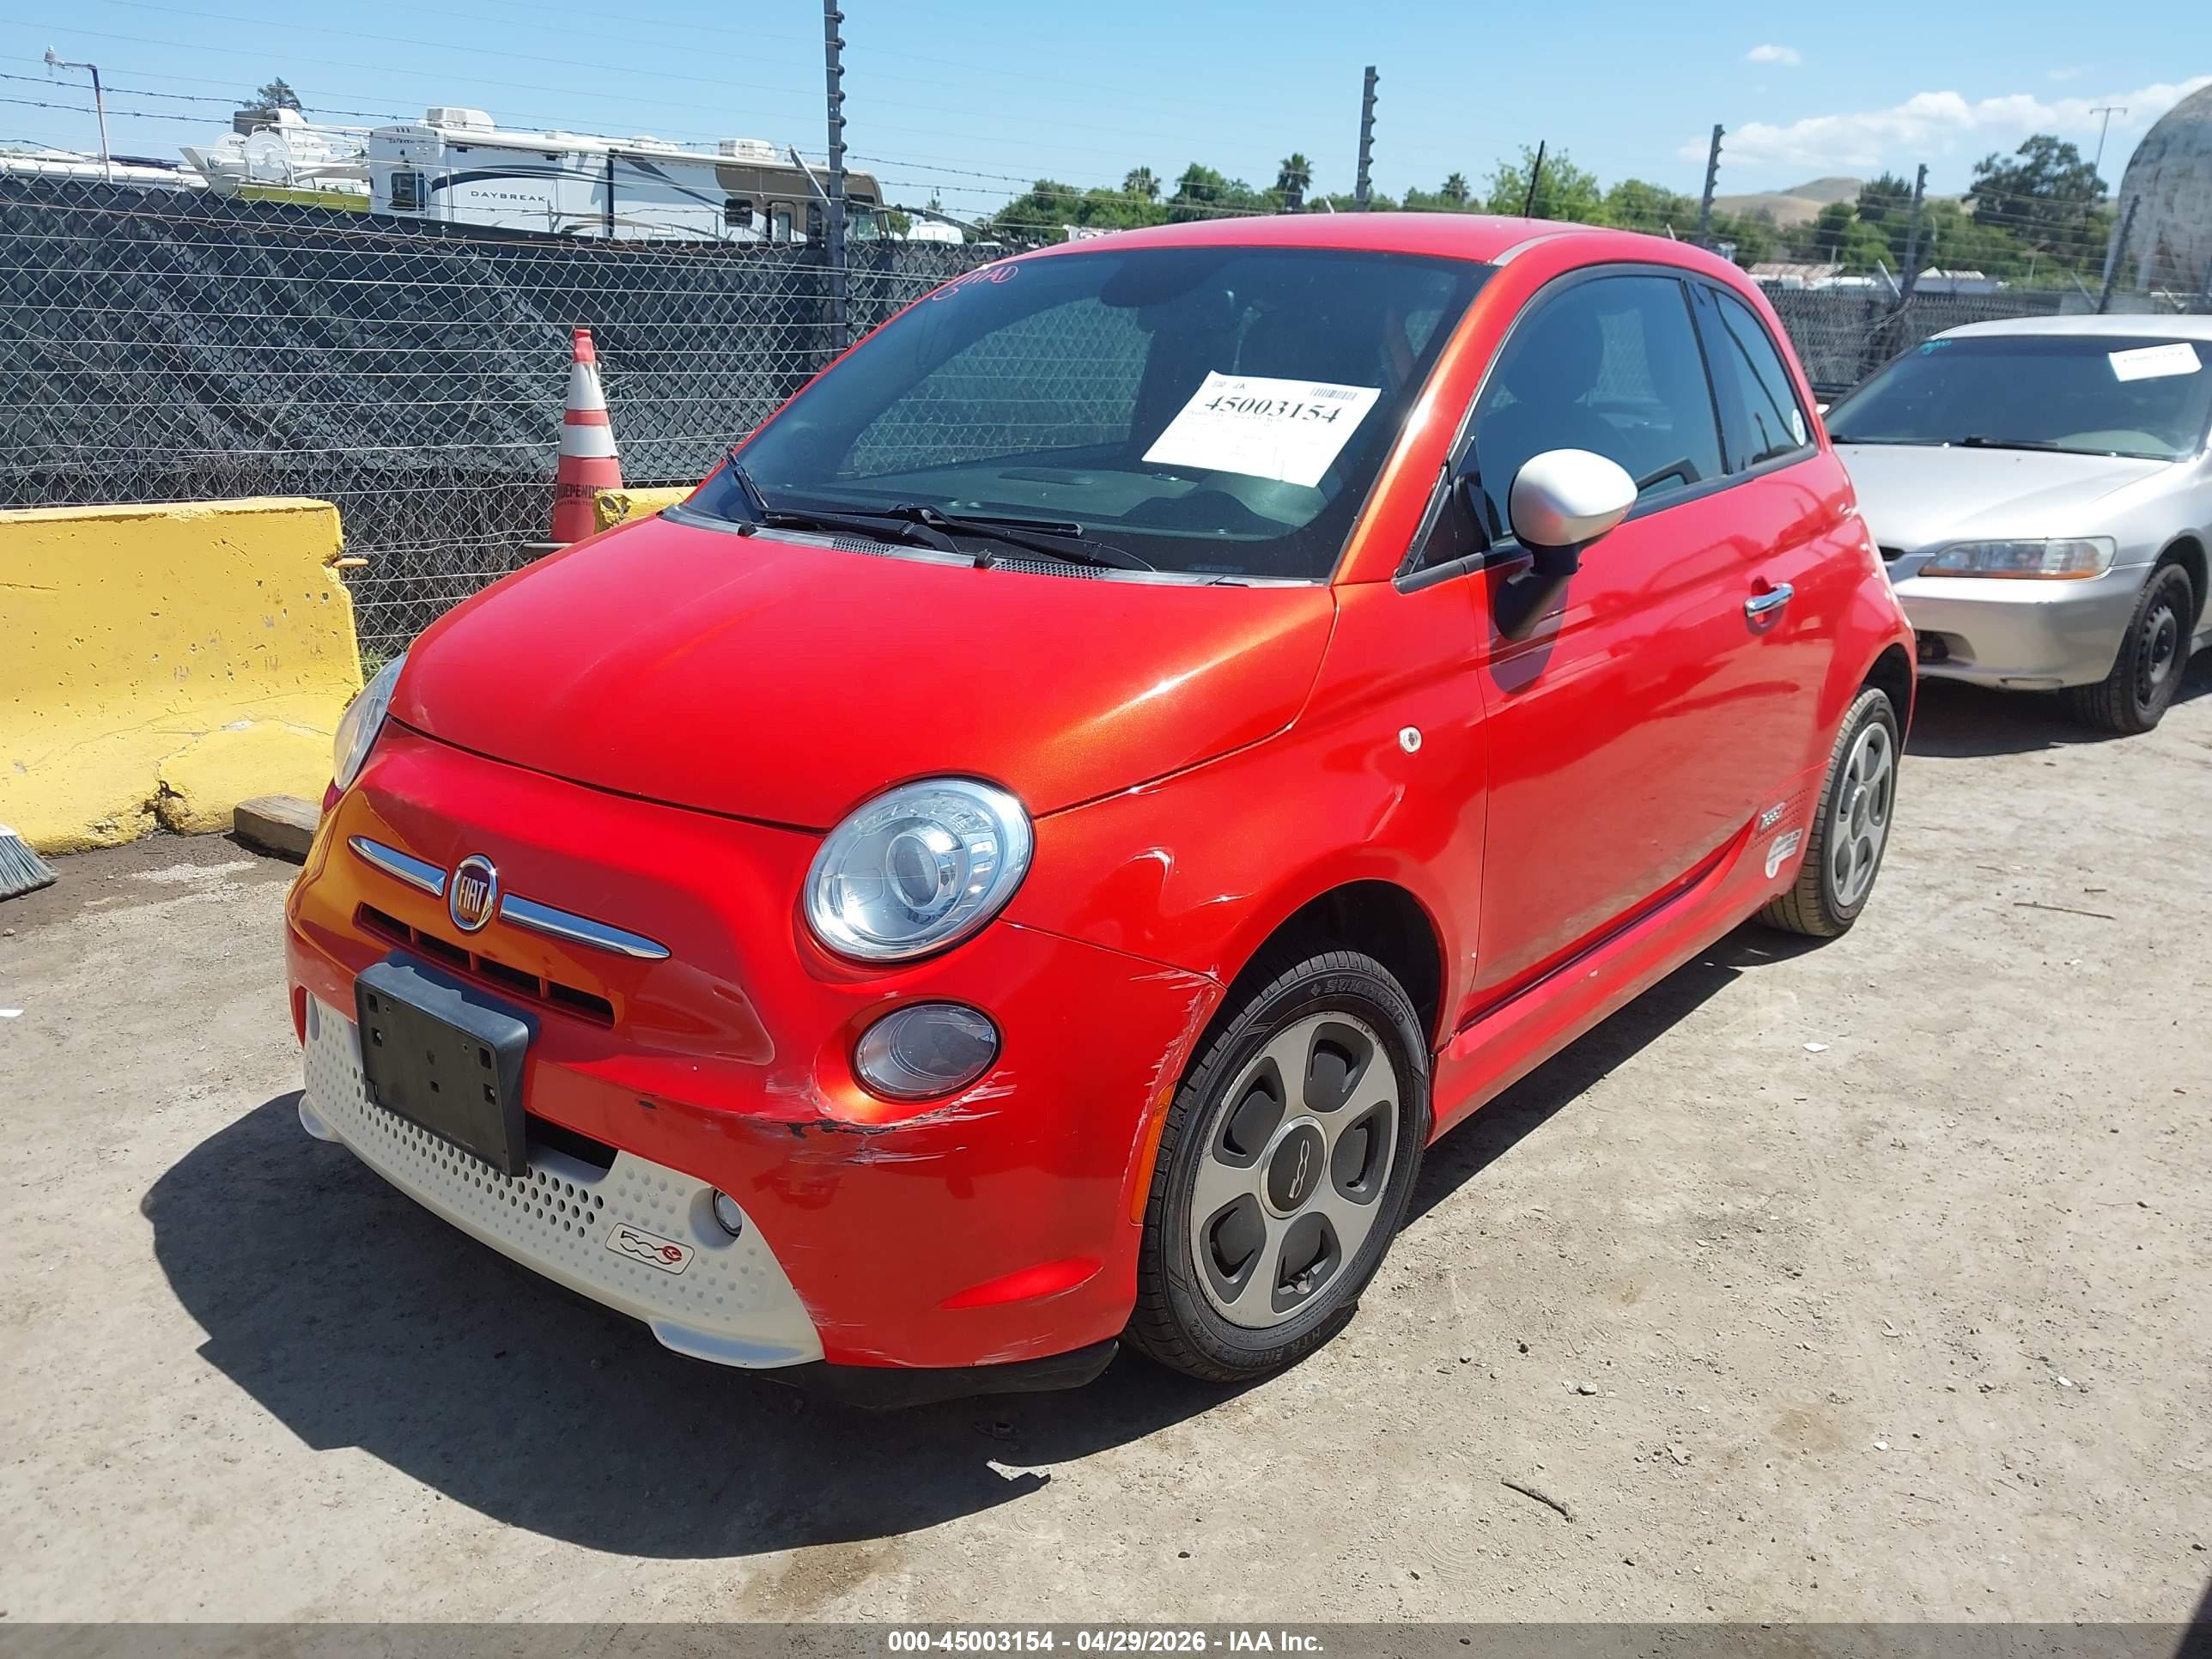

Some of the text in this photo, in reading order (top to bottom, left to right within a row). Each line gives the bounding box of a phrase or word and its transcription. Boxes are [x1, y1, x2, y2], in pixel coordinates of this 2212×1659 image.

[471, 191, 545, 202] DAYBREAK
[1205, 395, 1342, 423] 45003154
[458, 876, 488, 913] FIAT
[620, 1230, 682, 1265] 500e
